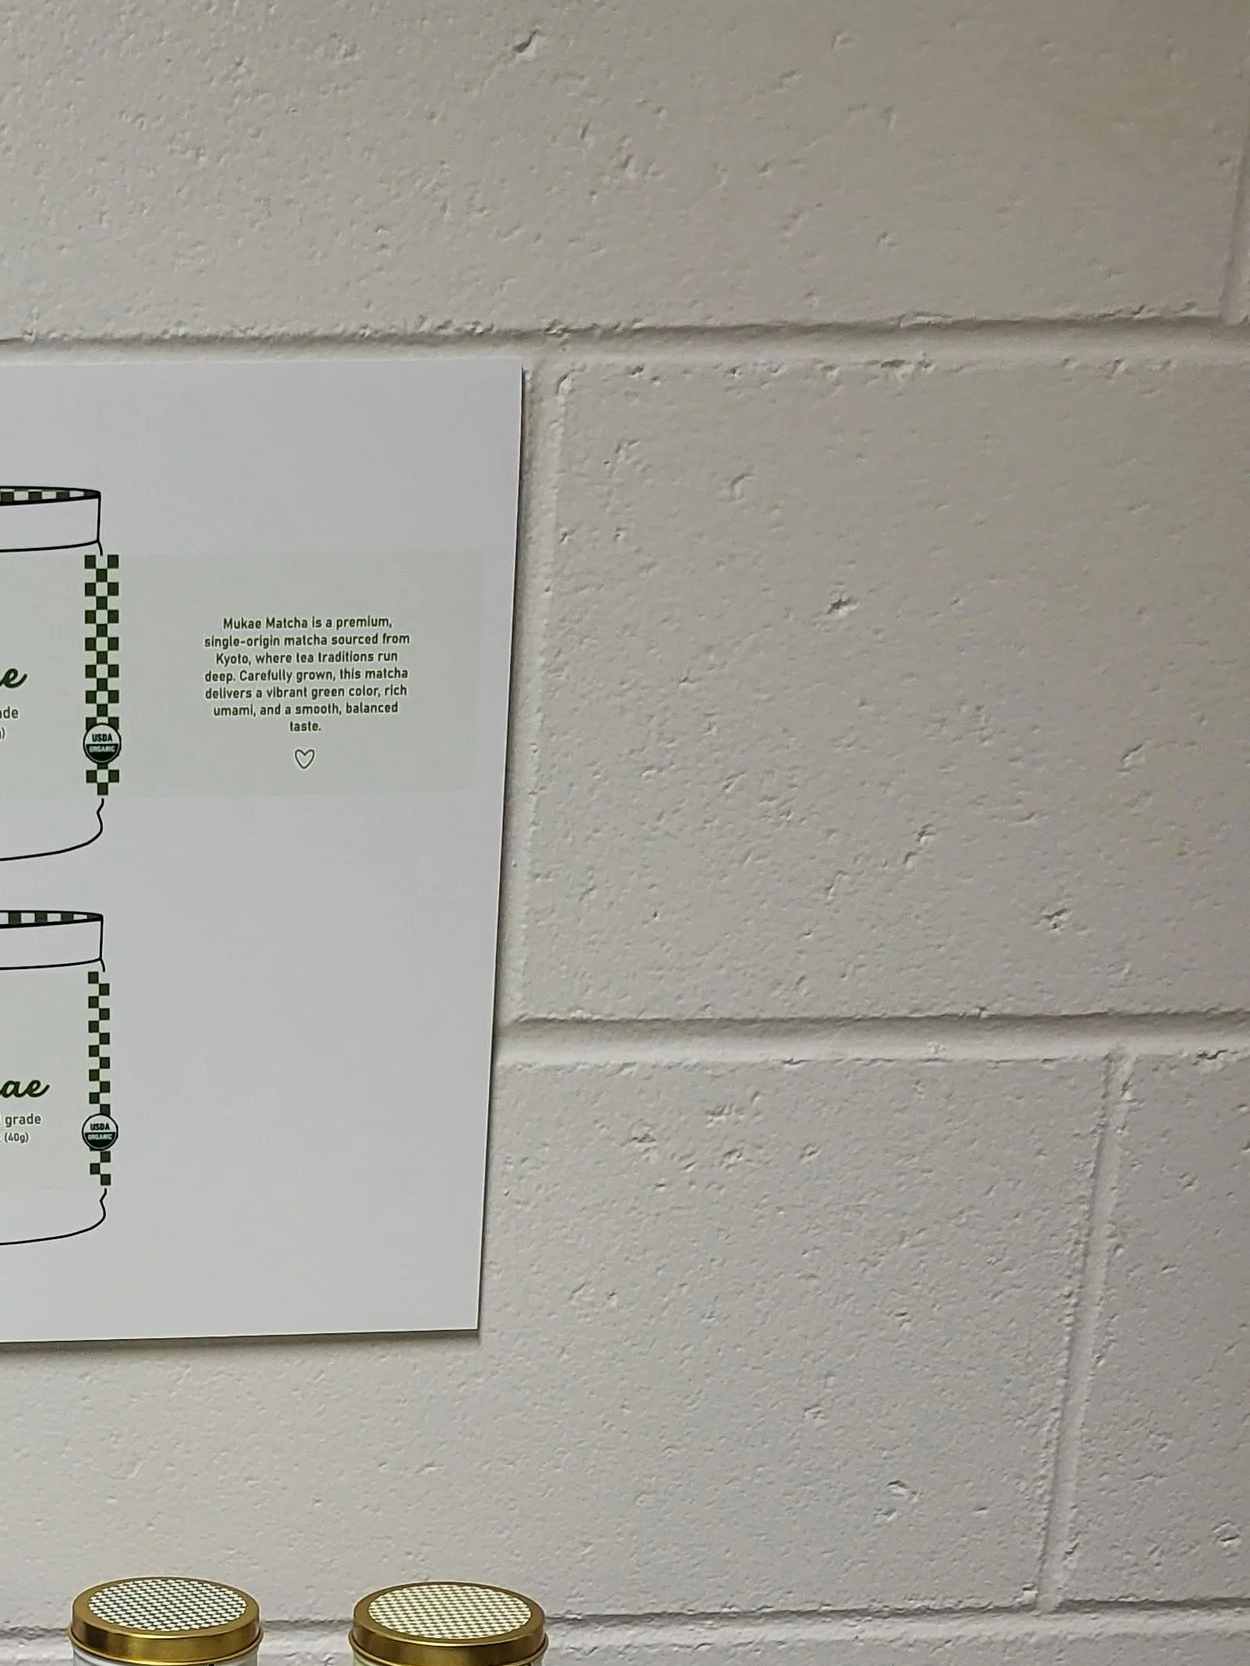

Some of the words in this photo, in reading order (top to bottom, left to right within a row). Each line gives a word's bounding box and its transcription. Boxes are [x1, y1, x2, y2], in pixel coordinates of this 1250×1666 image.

[223, 617, 262, 630] Mukae
[266, 616, 308, 629] Matcha
[312, 616, 322, 628] is
[326, 619, 332, 628] a
[336, 614, 392, 631] premium,
[204, 634, 280, 648] single-origin
[284, 635, 327, 646] matcha
[332, 633, 378, 646] sourced
[382, 632, 410, 644] from
[216, 651, 251, 666] Kyoto,
[256, 651, 292, 664] where
[296, 651, 314, 663] tea
[318, 650, 374, 662] traditions
[378, 651, 398, 661] run
[204, 669, 235, 684] deep.
[240, 669, 292, 683] Carefully
[296, 670, 336, 682] grown,
[340, 668, 360, 680] this
[365, 667, 408, 679] matcha
[205, 687, 252, 699] delivers
[256, 689, 262, 698] a
[267, 686, 307, 698] vibrant
[312, 687, 344, 700] green
[349, 685, 380, 698] color,
[384, 685, 407, 696] rich
[214, 703, 256, 718] umami,
[260, 703, 280, 716] and
[285, 705, 291, 714] a
[295, 702, 342, 716] smooth,
[346, 701, 398, 714] balanced
[290, 720, 321, 732] taste.
[92, 732, 112, 742] USDA
[5, 1112, 41, 1128] grade
[90, 1122, 110, 1130] USDA
[4, 1132, 29, 1143] (40g)
